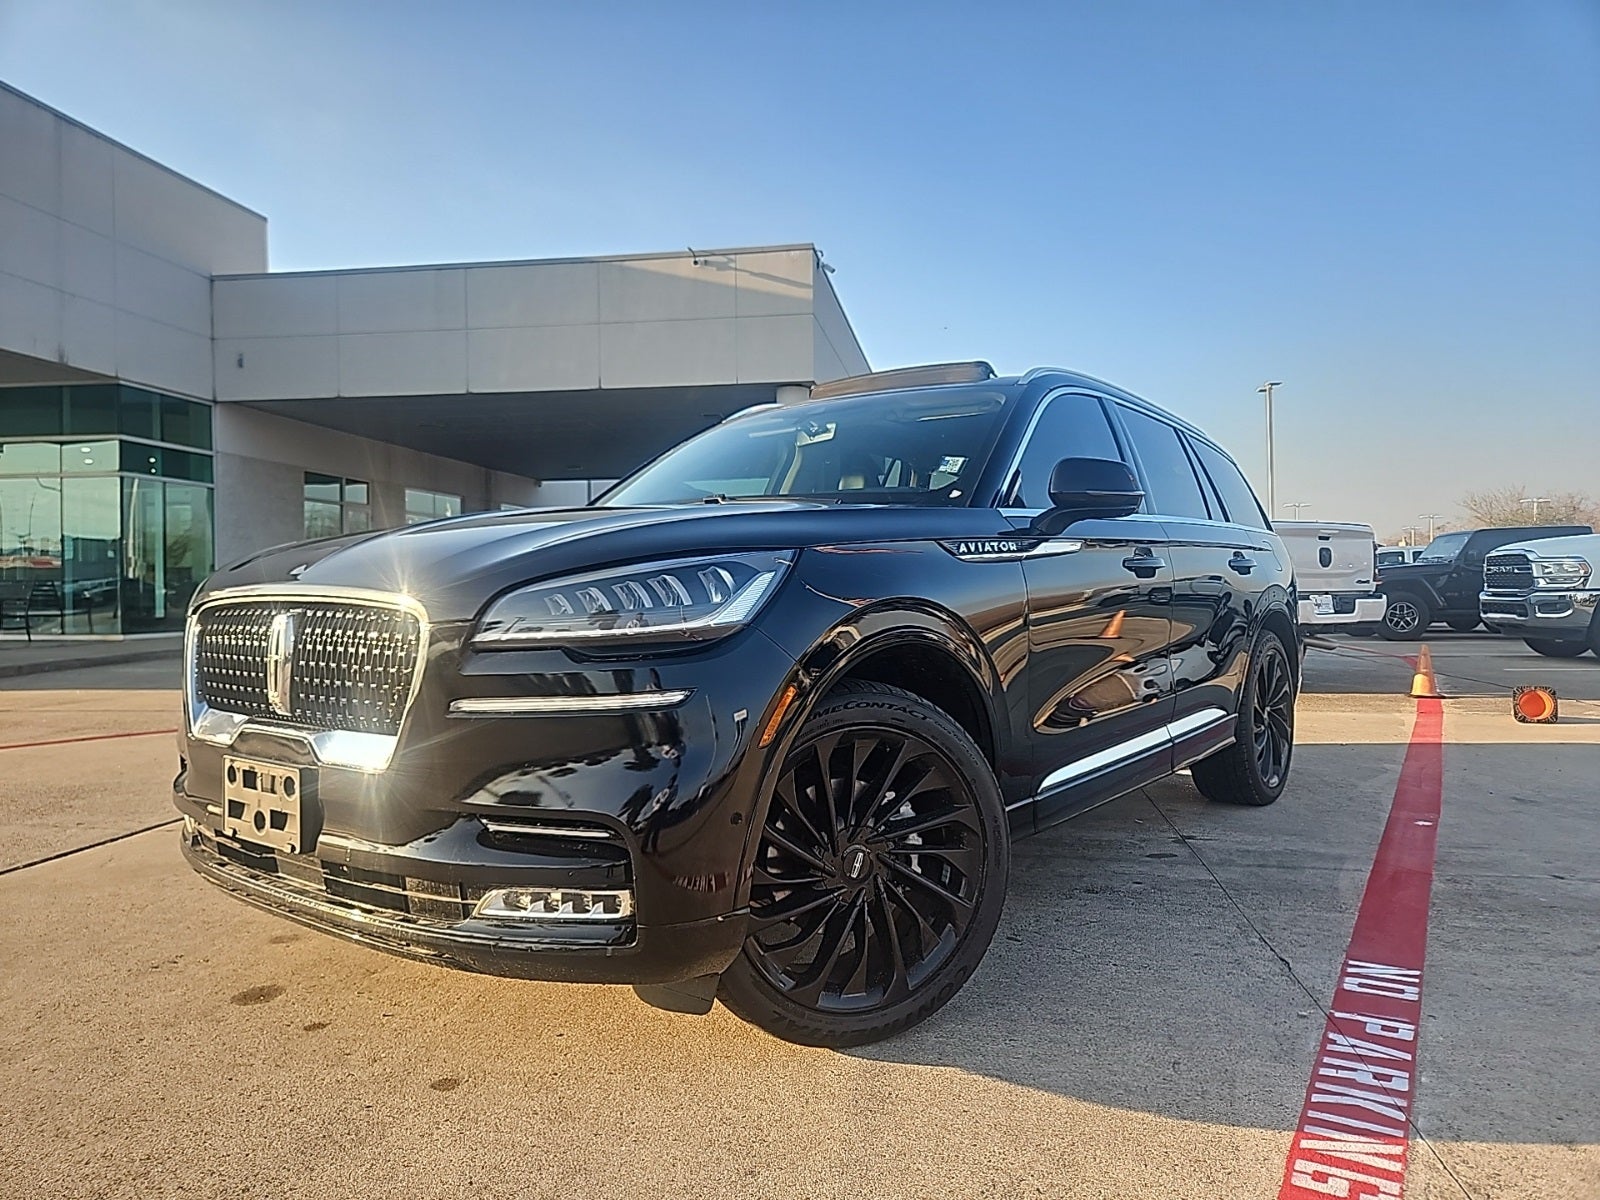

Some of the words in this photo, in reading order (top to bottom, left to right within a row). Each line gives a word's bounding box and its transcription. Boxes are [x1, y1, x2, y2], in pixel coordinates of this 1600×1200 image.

[958, 541, 1018, 554] AVIATOR
[1343, 959, 1421, 1001] NO
[1289, 1010, 1416, 1200] PARKING
